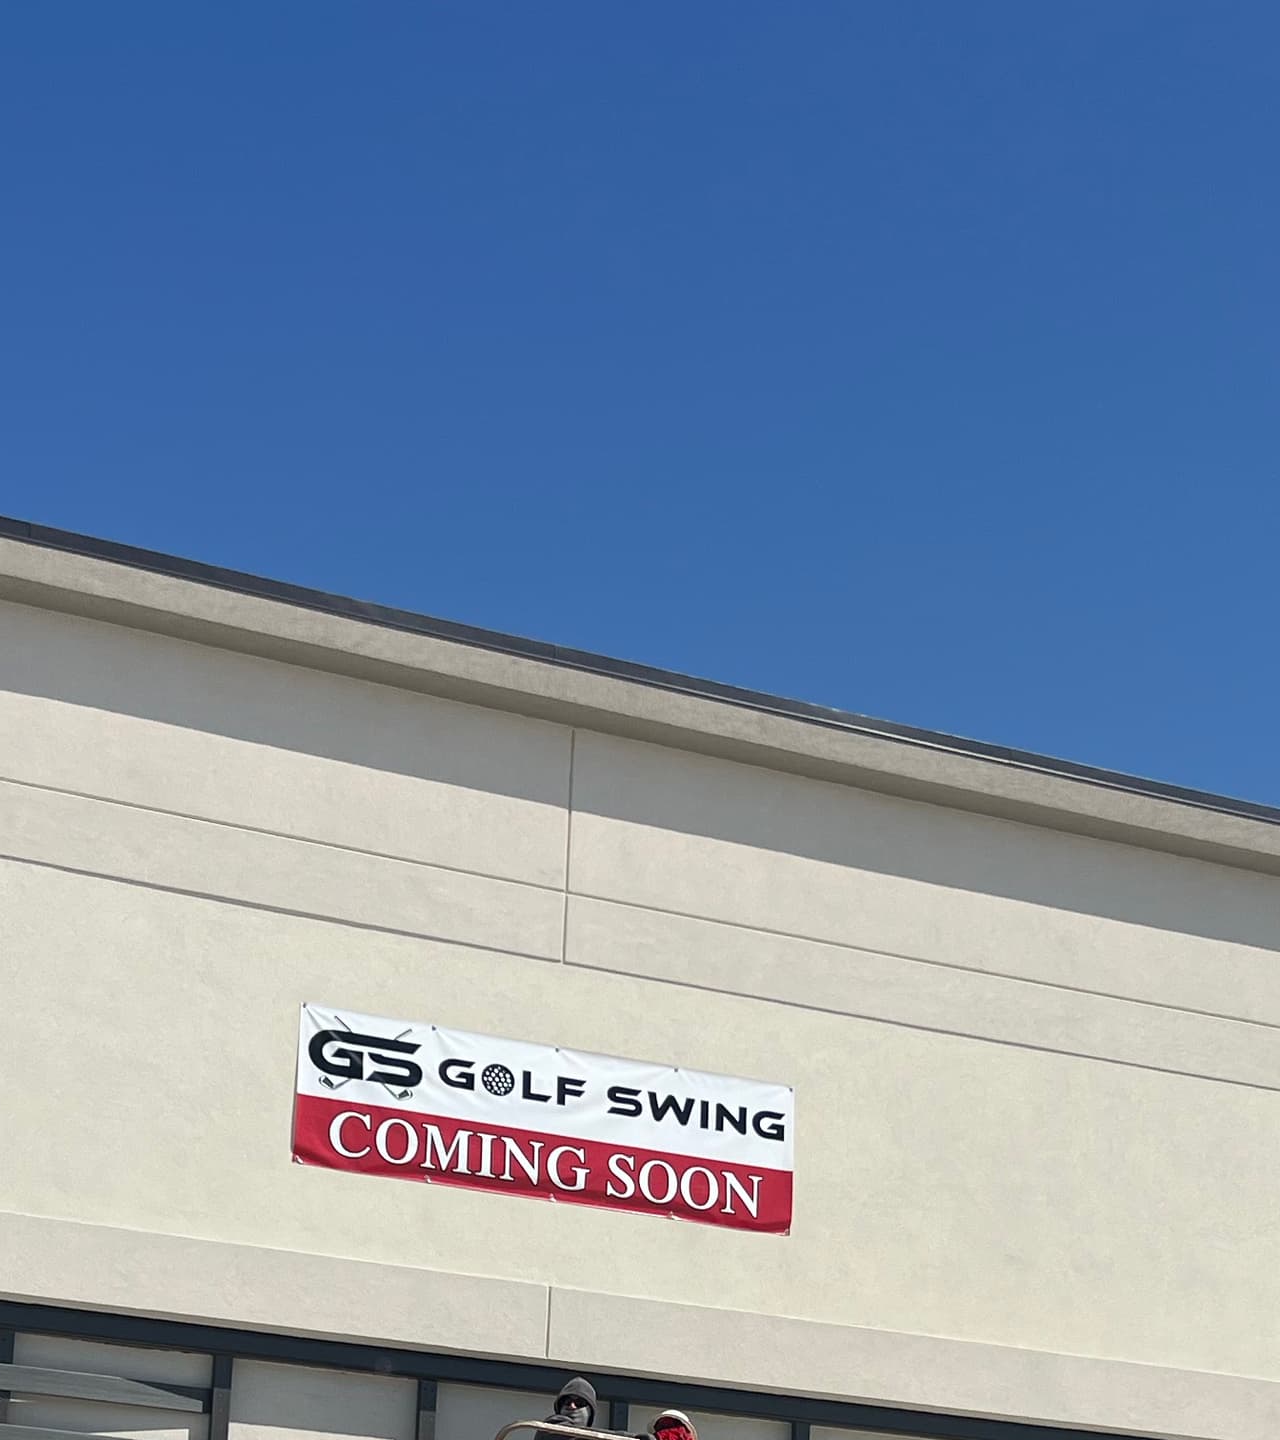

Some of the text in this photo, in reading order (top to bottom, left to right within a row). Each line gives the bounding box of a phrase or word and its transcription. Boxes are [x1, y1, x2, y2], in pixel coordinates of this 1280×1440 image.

[308, 1028, 786, 1142] GS GOLF SWING
[328, 1110, 764, 1219] COMING SOON
